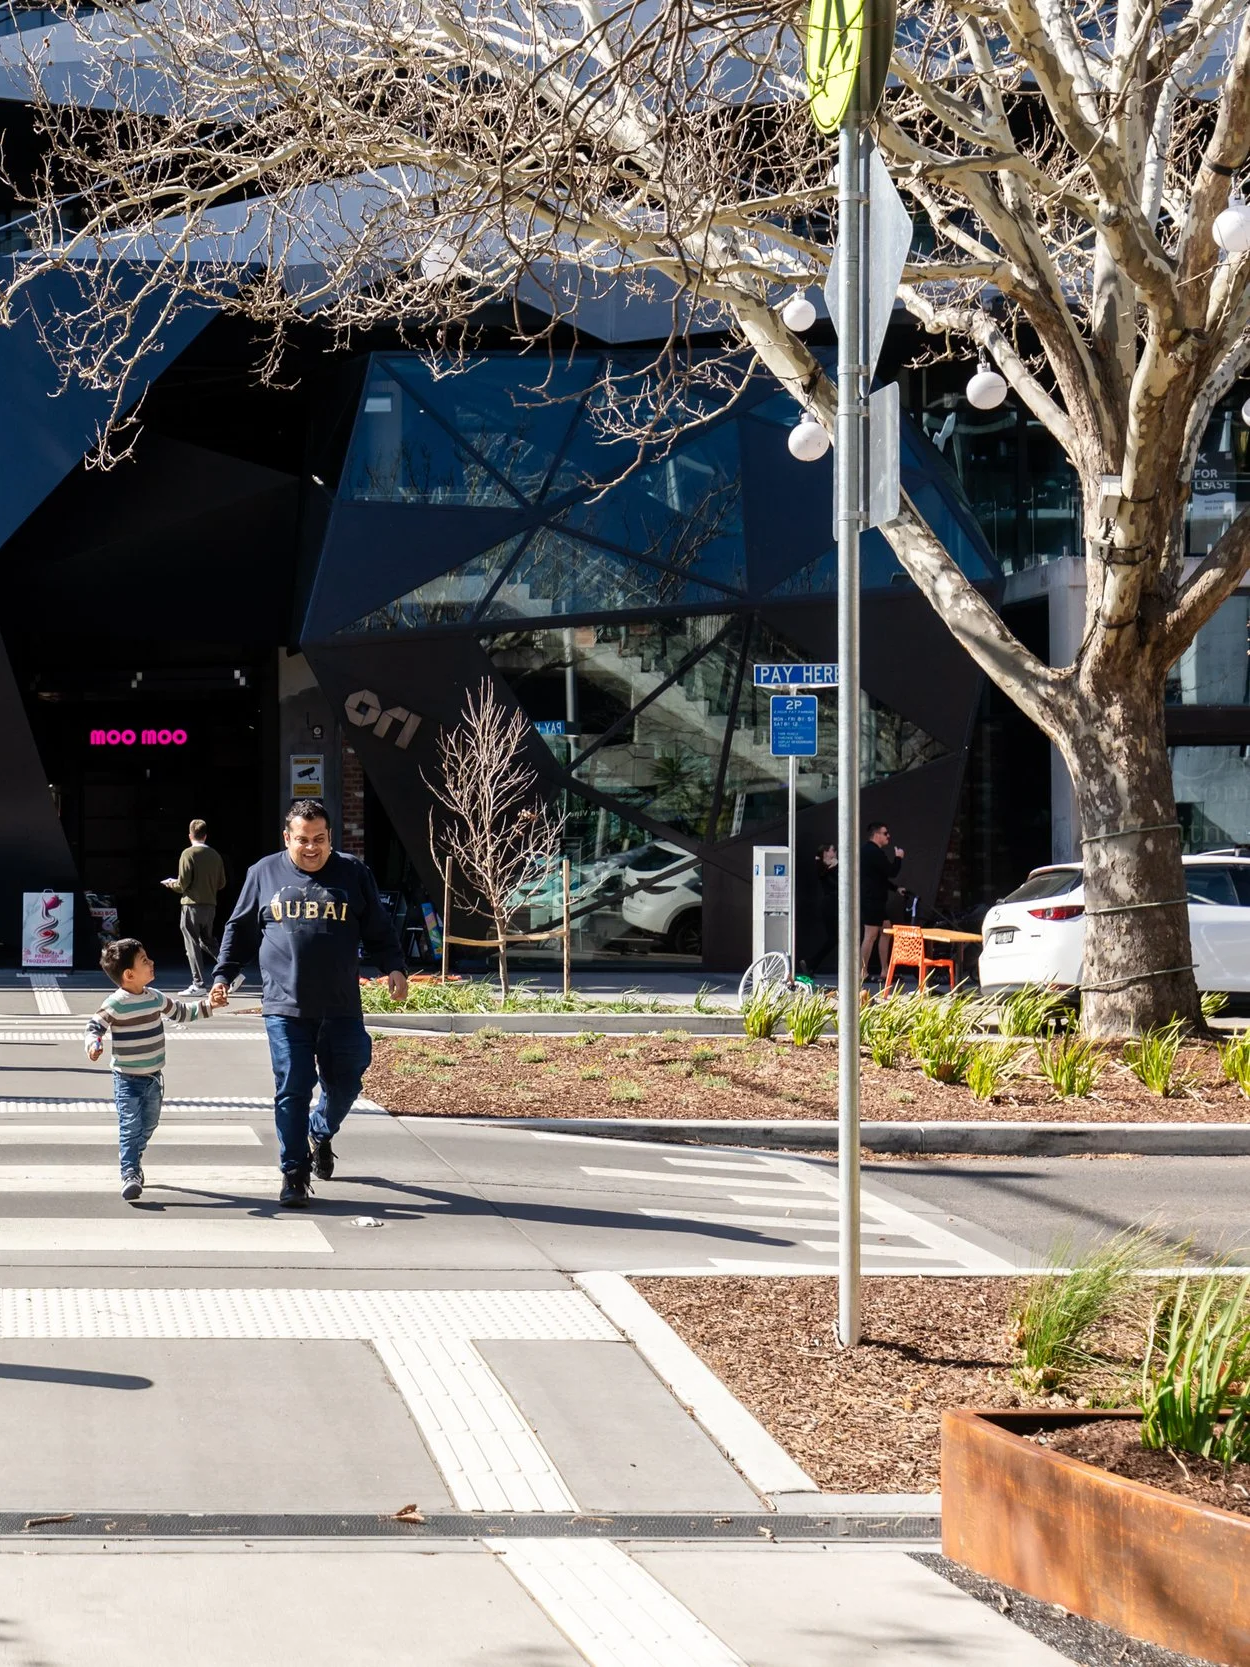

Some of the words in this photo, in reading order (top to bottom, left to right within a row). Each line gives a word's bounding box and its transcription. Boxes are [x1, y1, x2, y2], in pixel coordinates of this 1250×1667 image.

[1194, 469, 1218, 478] FOR
[1194, 480, 1230, 490] LEASE
[760, 666, 793, 683] PAY
[786, 700, 802, 710] 2P
